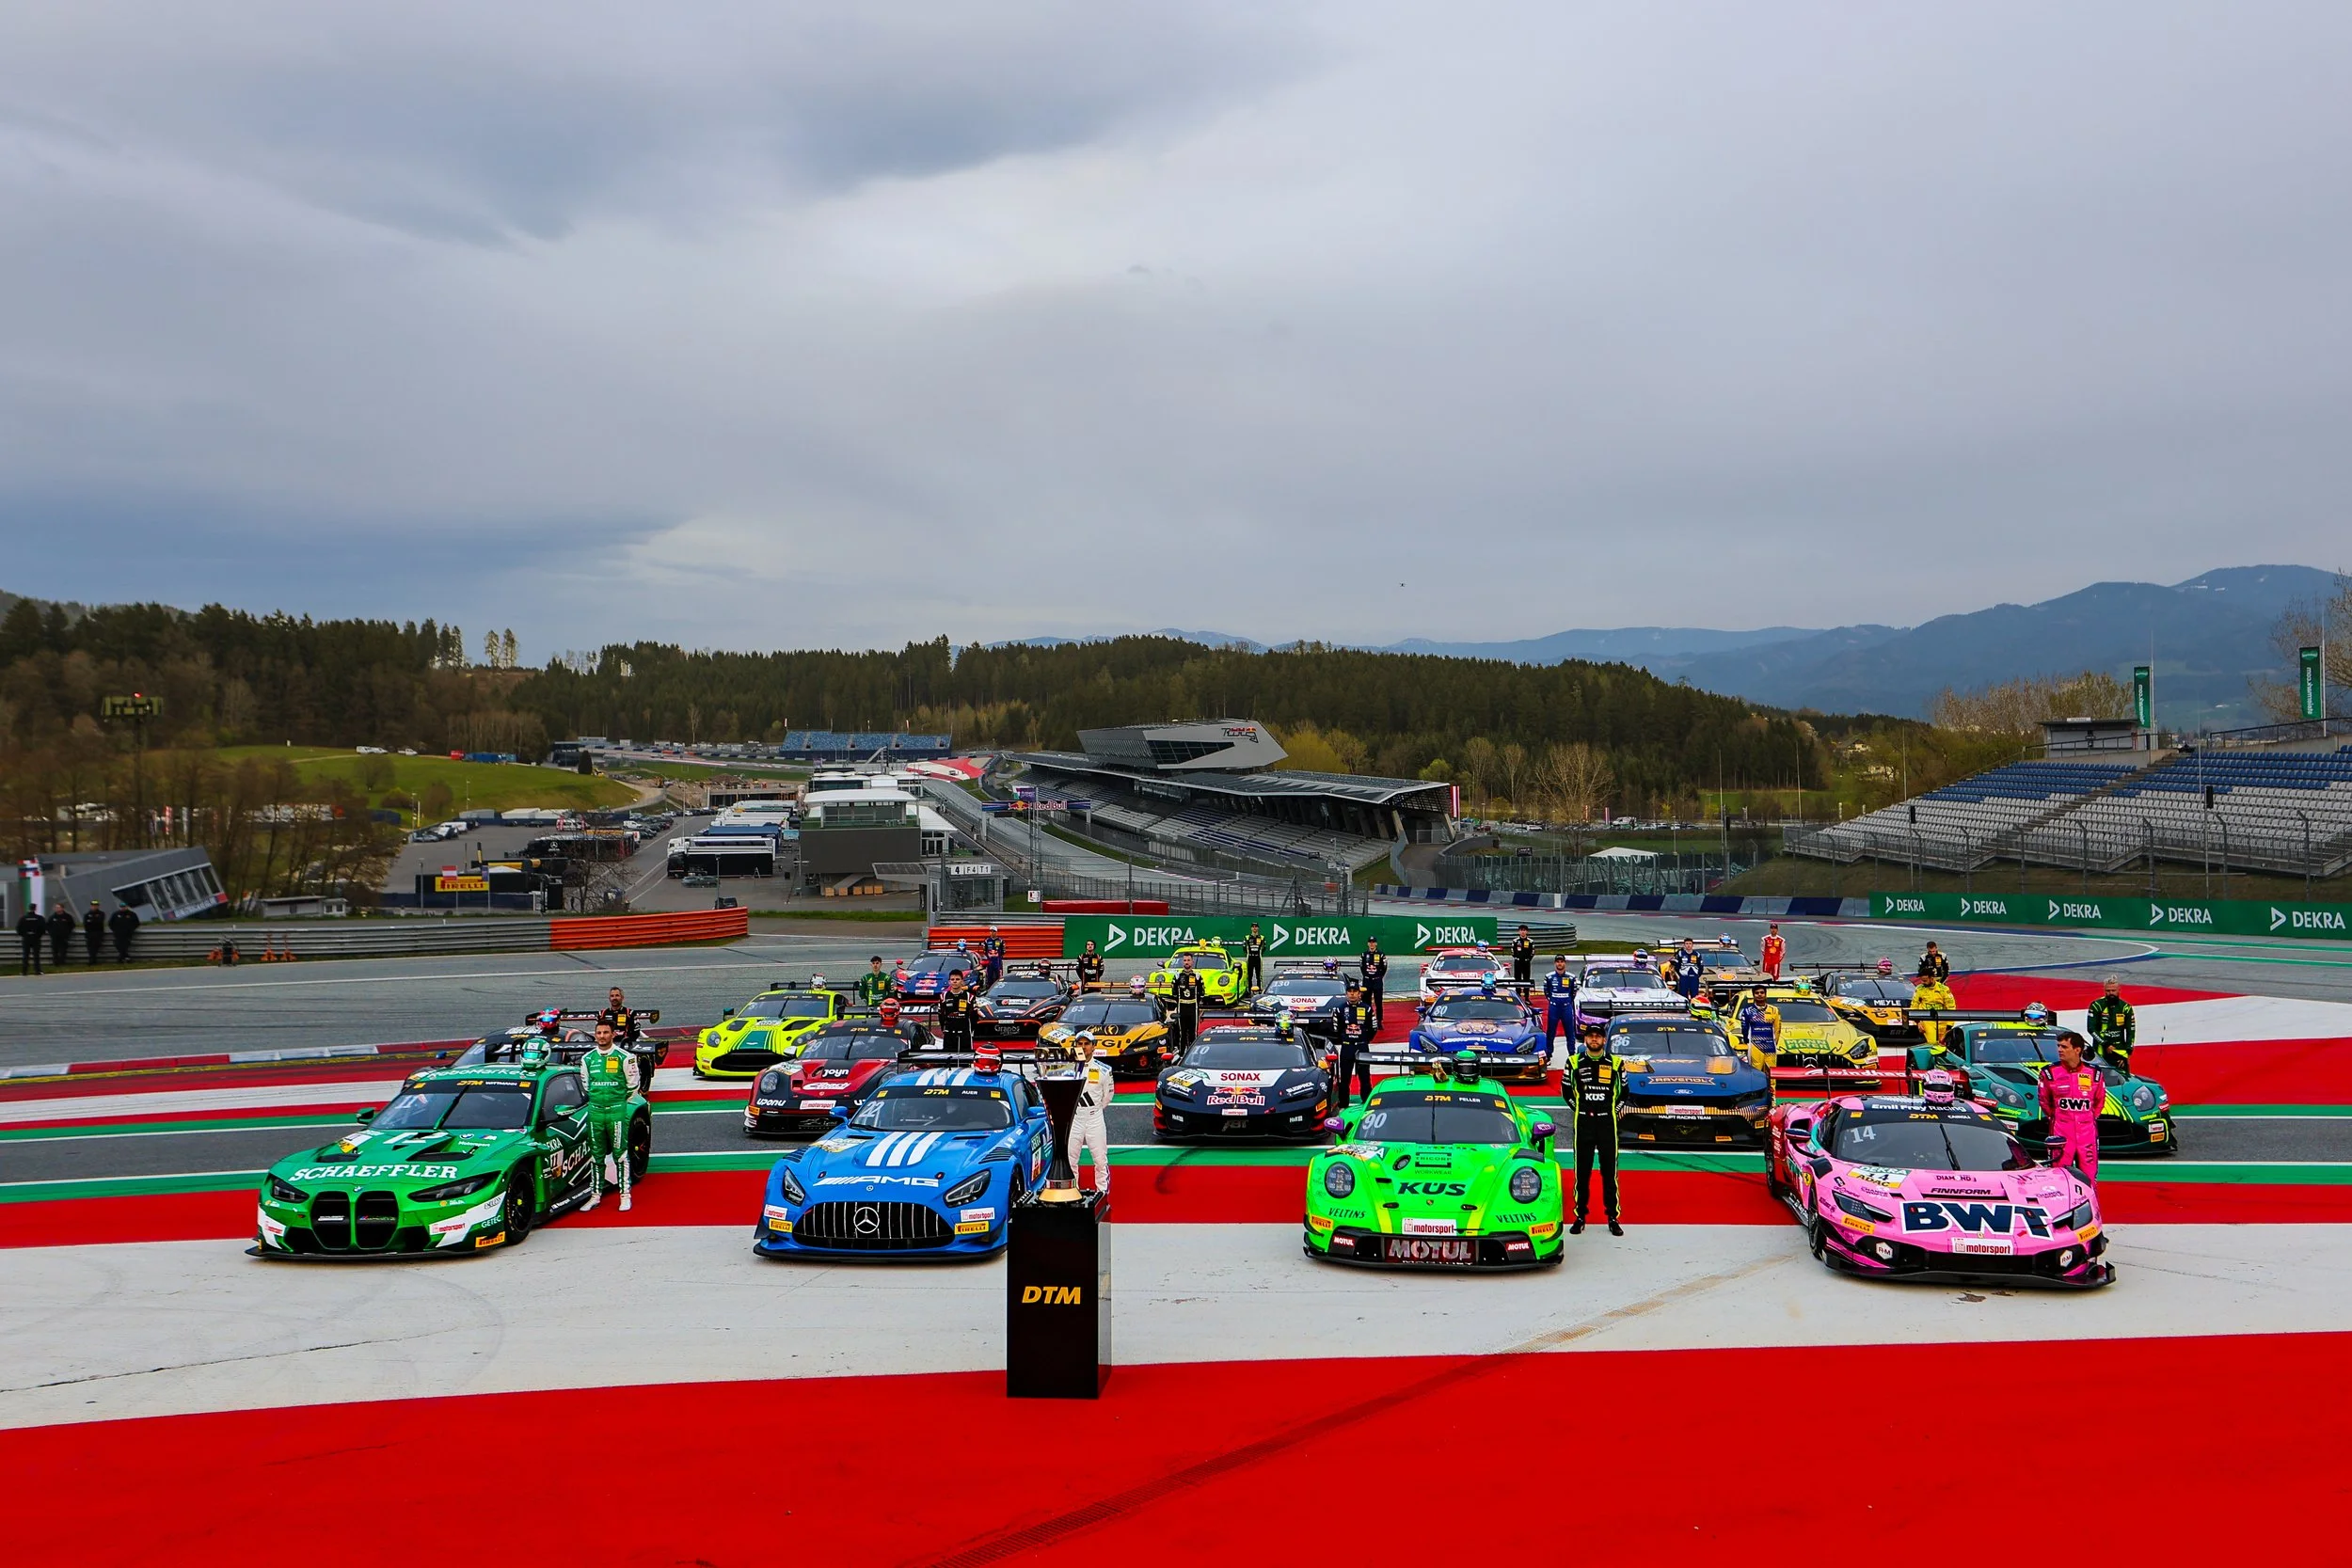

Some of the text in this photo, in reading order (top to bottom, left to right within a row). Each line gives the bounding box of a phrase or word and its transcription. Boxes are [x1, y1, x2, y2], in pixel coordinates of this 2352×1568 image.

[1051, 800, 1068, 811] Bull
[1897, 900, 1925, 912] DEKRA
[1974, 901, 2007, 915] DEKRA
[2063, 904, 2102, 919] DEKRA
[2169, 908, 2213, 925] DEKRA
[2293, 912, 2346, 929] DEKRA
[1295, 927, 1351, 945] DEKRA
[1436, 927, 1476, 943] DEKRA
[1193, 1045, 1210, 1055] 10
[822, 1069, 850, 1077] joyn
[1220, 1072, 1261, 1082] SONAX
[756, 1098, 787, 1107] uponu
[1207, 1095, 1265, 1106] Red Bull
[859, 1101, 885, 1118] 22
[1362, 1112, 1387, 1129] 90
[1851, 1125, 1877, 1144] 14
[288, 1164, 458, 1182] SCHAEFFLER
[1859, 1164, 1908, 1175] DEKRA
[854, 1175, 939, 1188] AMG
[1856, 1175, 1890, 1187] ADAC
[1398, 1180, 1466, 1196] KÜS
[1931, 1187, 1991, 1196] FINNFORM
[1327, 1207, 1366, 1219] VELTINS
[1496, 1212, 1537, 1224] VELTINS
[1900, 1201, 2055, 1240] BWT
[1413, 1224, 1454, 1234] motorsport
[1333, 1236, 1355, 1246] MOTUL
[1507, 1242, 1530, 1251] MOTUL
[1388, 1239, 1472, 1259] MOTUL
[1966, 1243, 2011, 1255] motorsport
[1022, 1286, 1081, 1306] DTM
